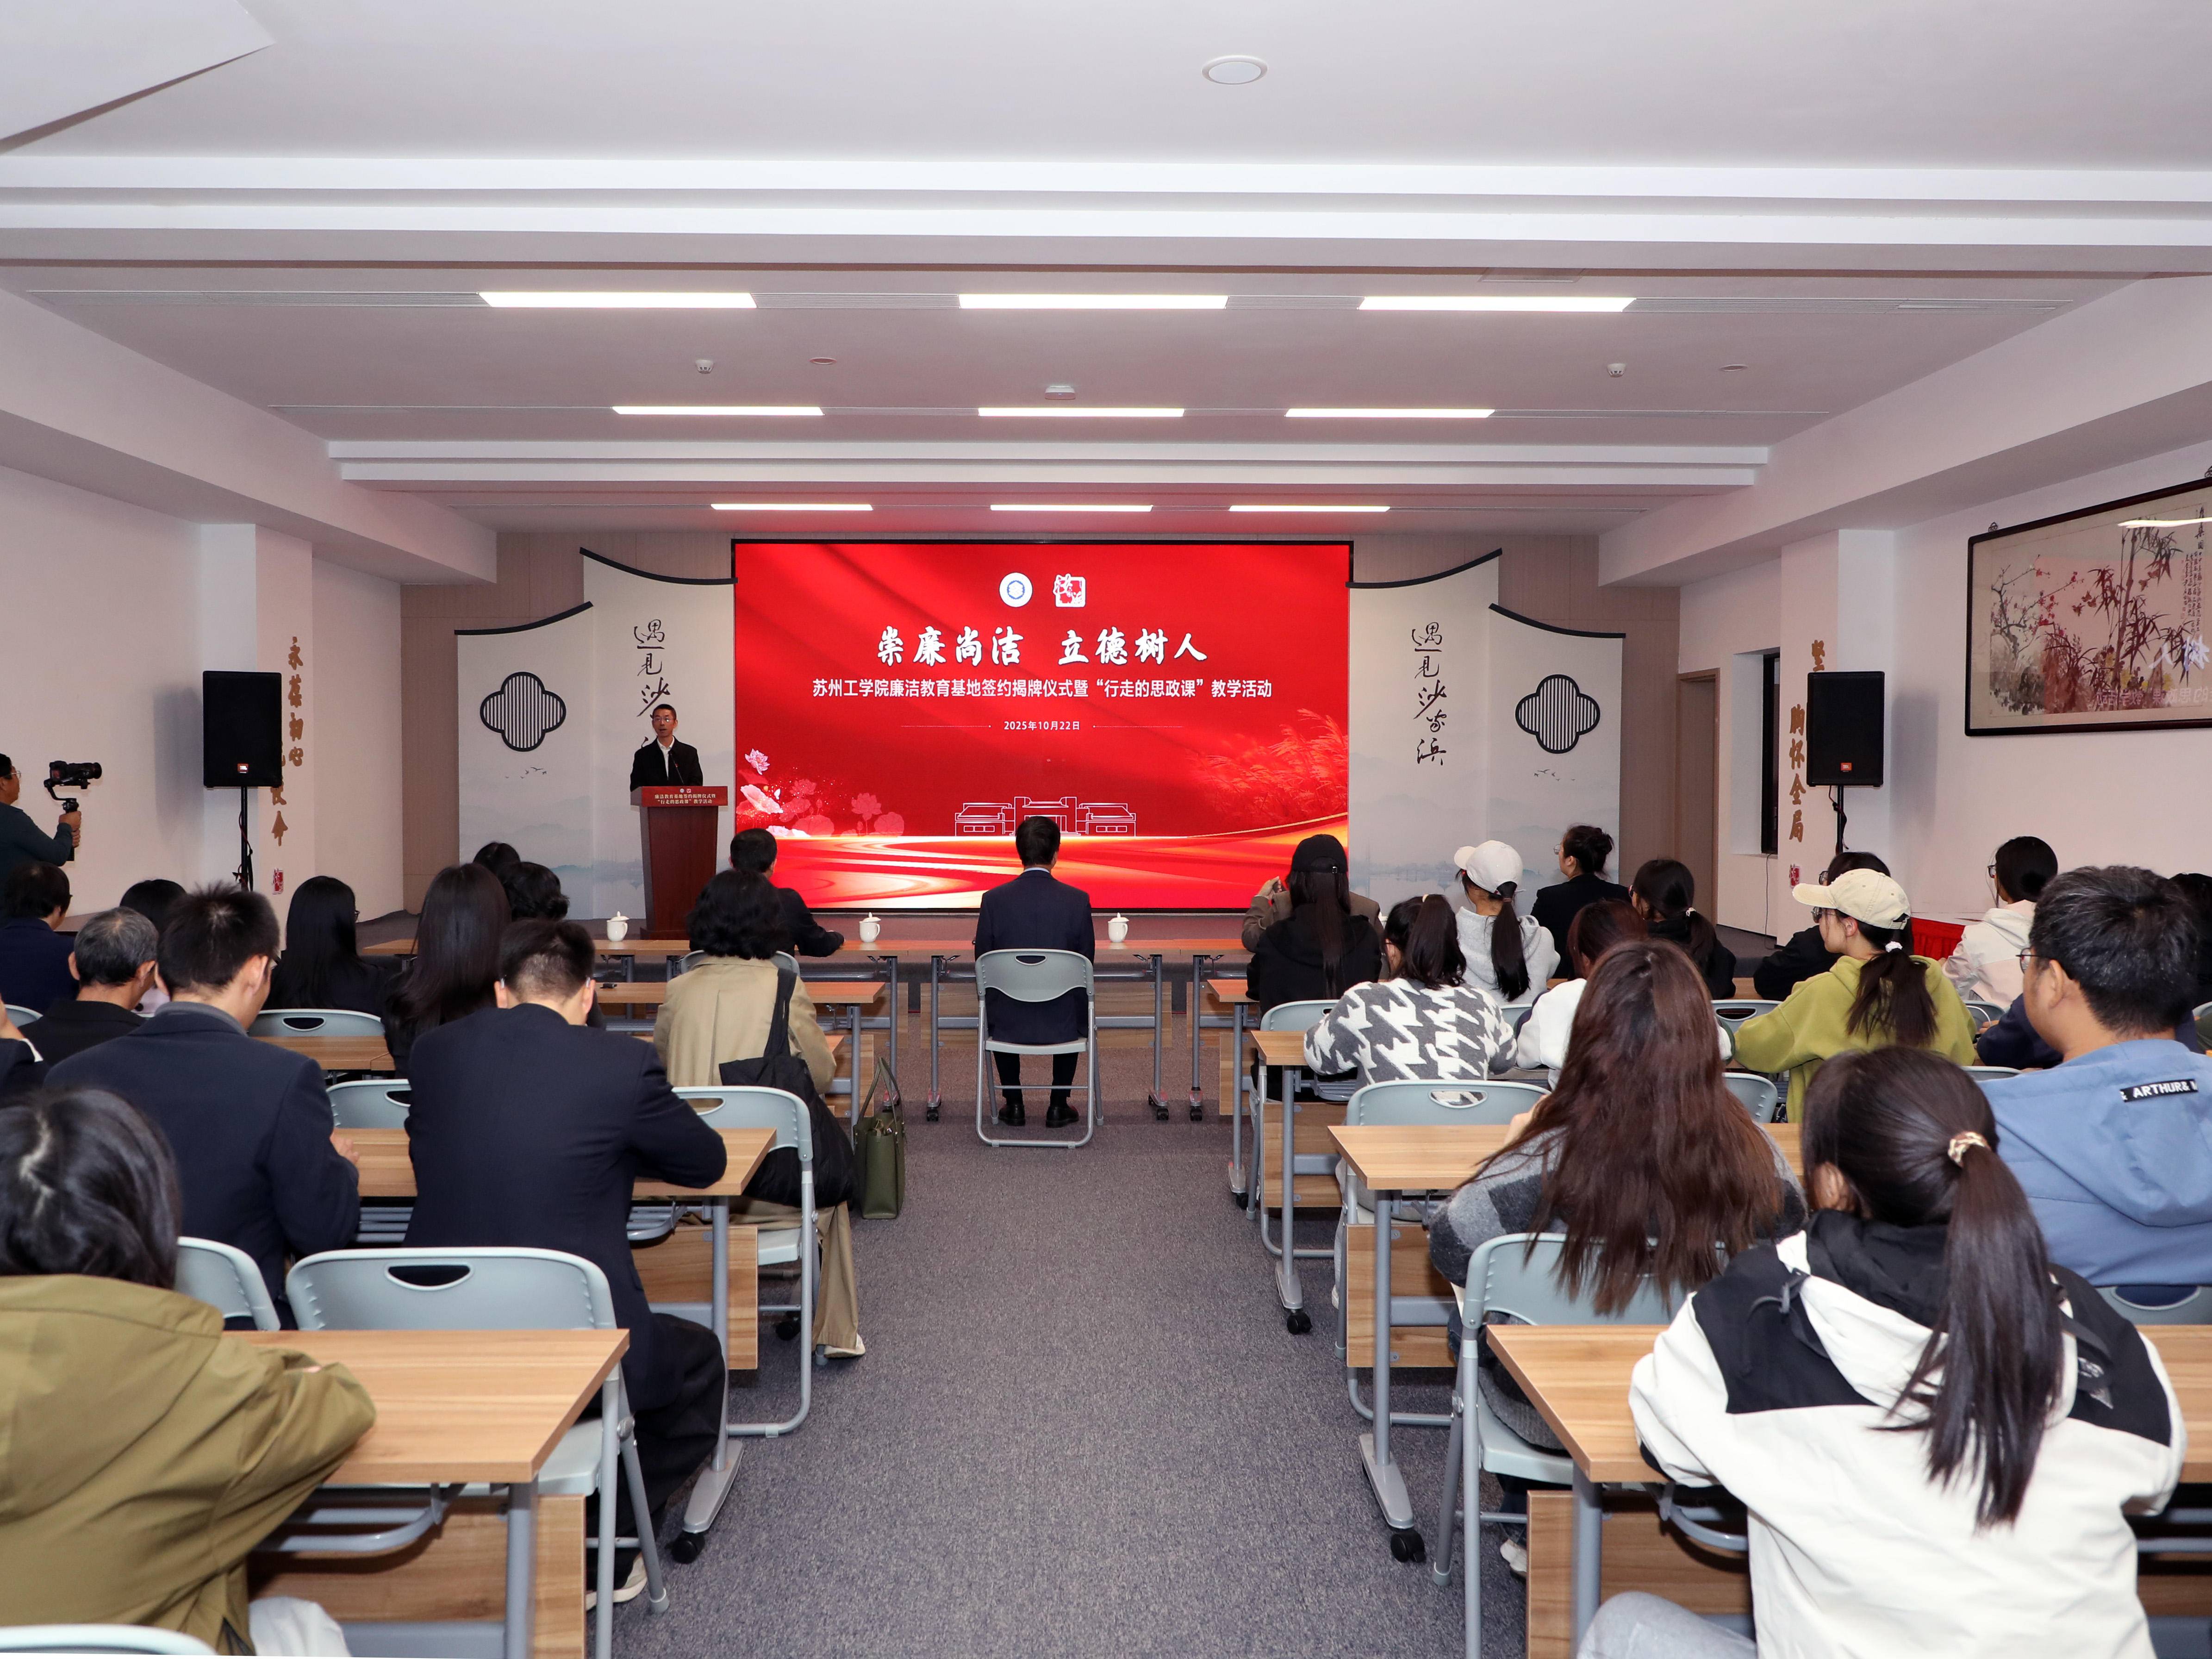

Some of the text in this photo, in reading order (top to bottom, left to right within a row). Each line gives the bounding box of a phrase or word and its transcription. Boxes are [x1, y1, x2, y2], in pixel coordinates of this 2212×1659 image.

[634, 619, 671, 748] 遇见沙
[878, 626, 1208, 667] 崇廉尚洁 立德树人
[1412, 622, 1447, 766] 遇见沙家浜
[1004, 720, 1080, 731] 2025年10月22日
[1789, 704, 1806, 842] 胸怀全局
